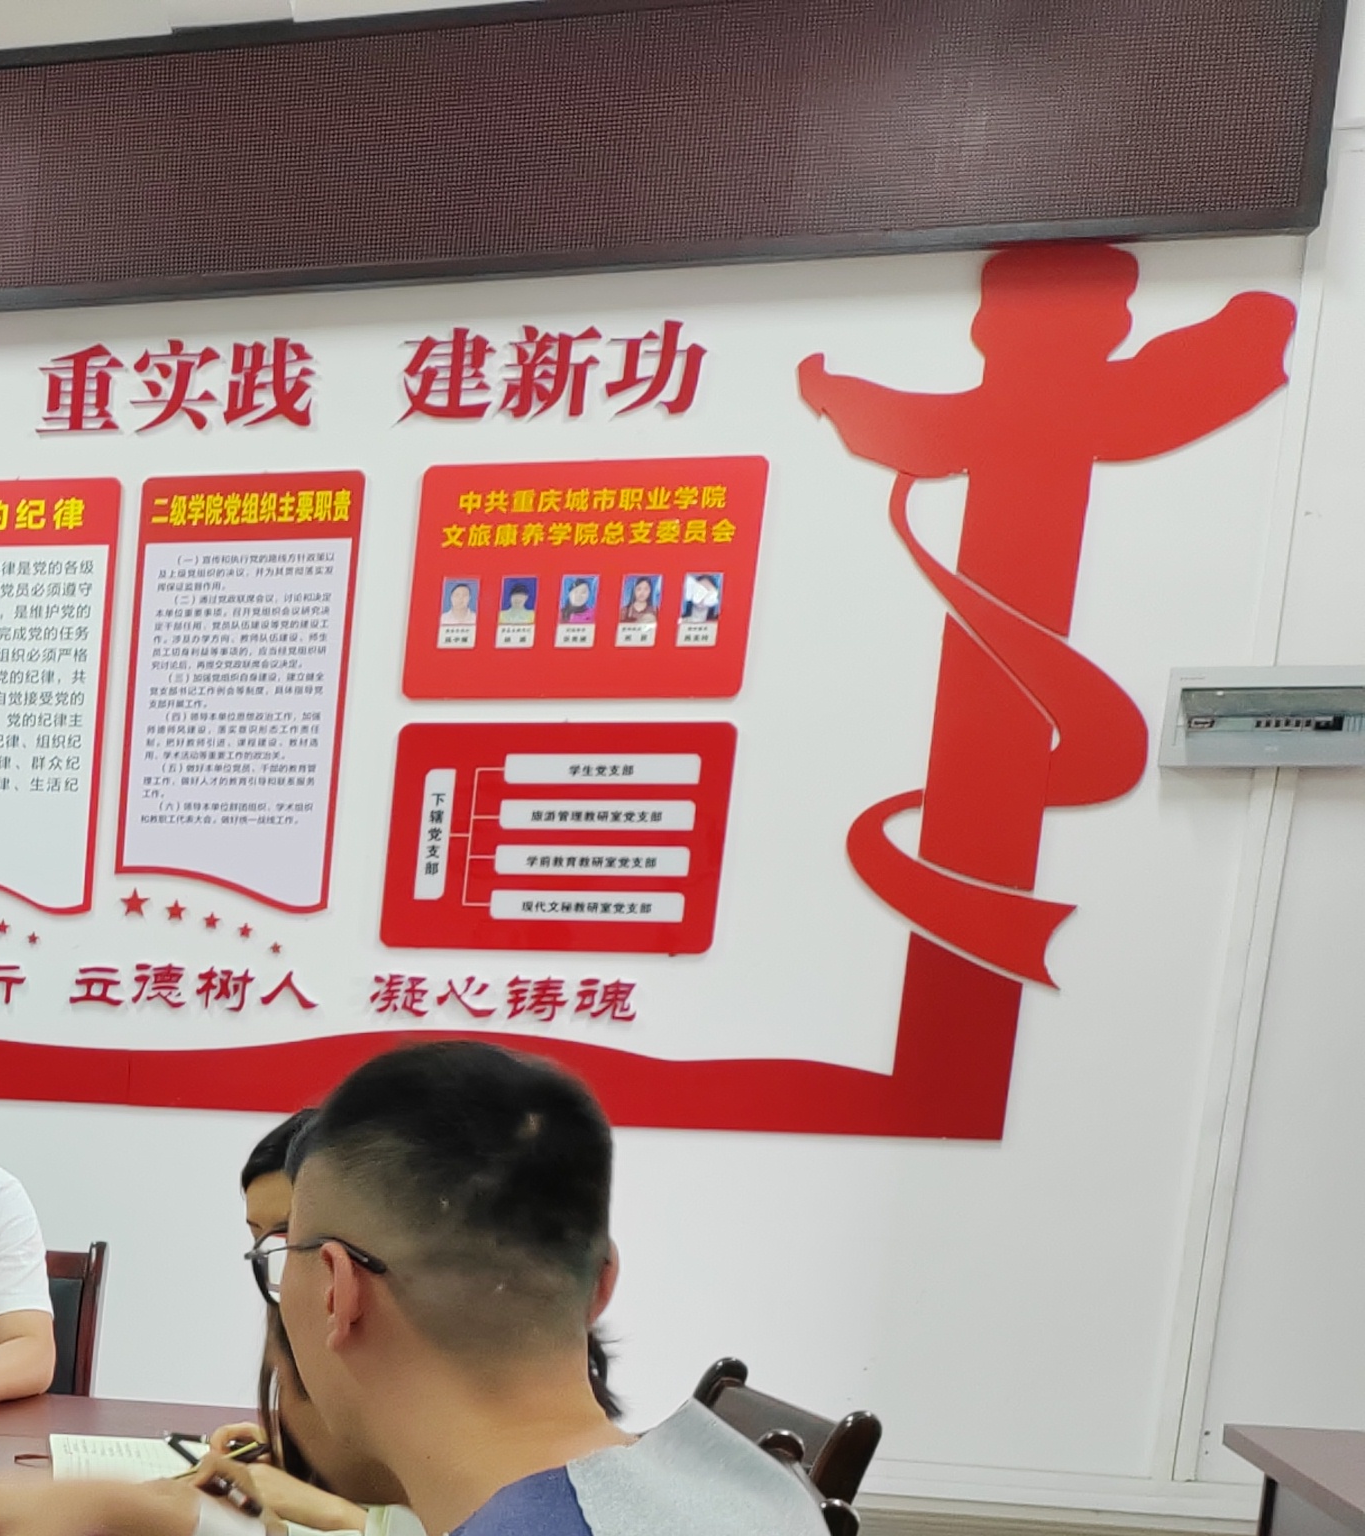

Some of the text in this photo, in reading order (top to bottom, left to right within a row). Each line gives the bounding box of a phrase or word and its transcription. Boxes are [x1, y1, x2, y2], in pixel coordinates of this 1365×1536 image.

[35, 336, 317, 436] 重实践
[394, 320, 708, 428] 建新功
[151, 489, 351, 526] 二级学院党组织主要职责
[459, 485, 727, 514] 中共重庆城市职业学院
[441, 518, 737, 548] 文旅康养学院总支委员会
[568, 764, 634, 777] 学生党支部
[530, 810, 663, 823] 旅游管理教研室党支部
[424, 793, 446, 876] 下辖党支部
[526, 855, 658, 869] 学前教育教研室党支部
[69, 962, 319, 1010] 立德树人
[369, 974, 638, 1022] 凝心铸魂
